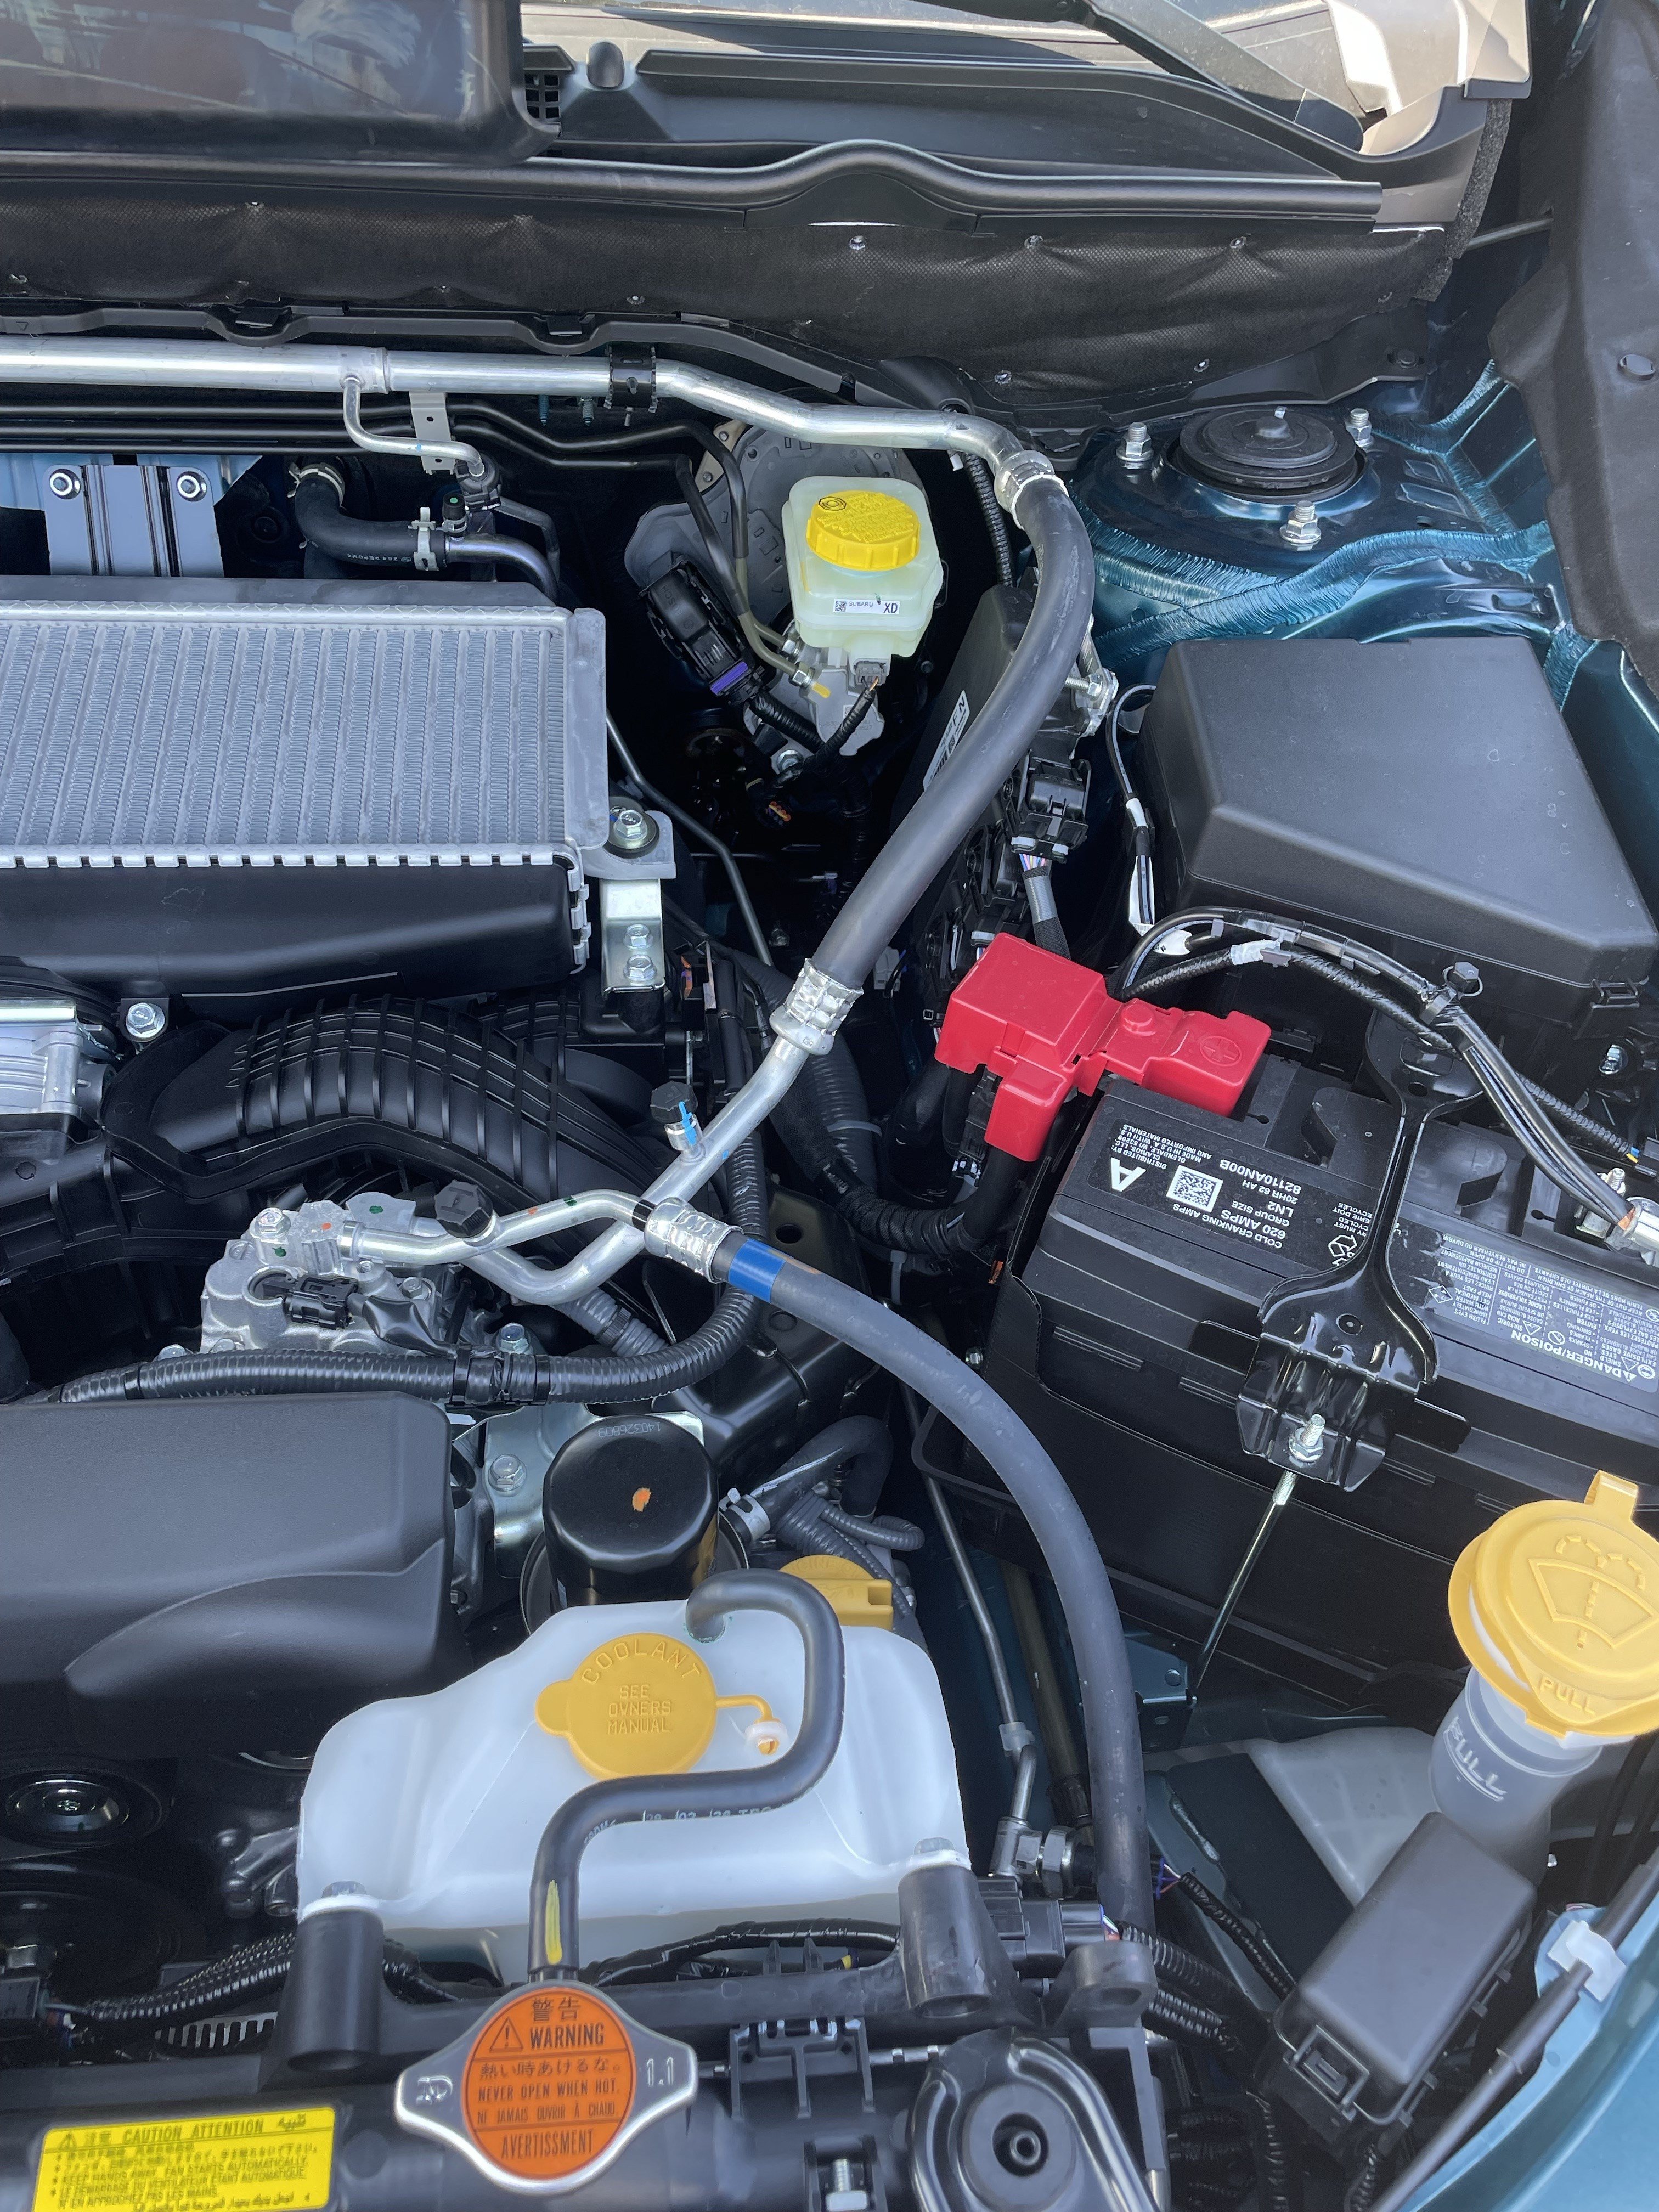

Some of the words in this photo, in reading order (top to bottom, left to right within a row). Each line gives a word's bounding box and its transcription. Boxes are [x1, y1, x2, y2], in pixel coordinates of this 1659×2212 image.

[883, 602, 898, 614] XD
[1119, 1128, 1132, 1137] U.S.
[1122, 1124, 1160, 1141] MATERIALS
[1132, 1133, 1150, 1144] WITH
[1110, 1144, 1122, 1153] BY:
[1150, 1140, 1172, 1152] U.S.A.
[1161, 1138, 1196, 1154] IMPORTED
[1122, 1149, 1167, 1169] DISTRIBUTED
[1181, 1151, 1201, 1163] MADE
[1197, 1150, 1212, 1159] AND
[1110, 1158, 1145, 1191] A
[1220, 1159, 1301, 1194] 82110AN00B
[1242, 1180, 1257, 1189] AH
[1258, 1185, 1270, 1194] 62
[1271, 1190, 1298, 1204] 20HR
[1172, 1203, 1200, 1217] AMPS
[1231, 1200, 1253, 1214] SIZE
[1267, 1201, 1294, 1217] LN2
[1331, 1207, 1351, 1217] DOIT
[1338, 1202, 1372, 1218] ECYCLÉE
[1221, 1209, 1260, 1229] AMPS
[1254, 1210, 1289, 1226] GROUP
[1338, 1217, 1368, 1231] CYCLED
[1352, 1214, 1371, 1224] ERIE
[1201, 1214, 1252, 1238] CRANKING
[1262, 1224, 1285, 1239] 620
[1333, 1221, 1356, 1233] MUST
[1254, 1234, 1282, 1248] COLD
[1473, 1245, 1506, 1261] RENVERSER
[1449, 1271, 1463, 1280] YEUX
[1466, 1264, 1496, 1279] CONSULTEZ
[1464, 1276, 1474, 1284] LES
[1474, 1280, 1493, 1291] RINCEZ
[1560, 1276, 1571, 1284] DES
[1454, 1288, 1479, 1301] MEDICAL
[1477, 1290, 1492, 1299] HELP
[1498, 1289, 1527, 1304] SULFURIQUE
[1514, 1288, 1534, 1299] CAUSER
[1569, 1294, 1588, 1305] FUMER
[1575, 1288, 1594, 1299] REACH
[1594, 1295, 1605, 1303] THE
[1610, 1294, 1626, 1304] HORS
[1479, 1297, 1490, 1305] GET
[1500, 1297, 1517, 1308] BURNS
[1534, 1296, 1547, 1304] PEUT
[1559, 1297, 1584, 1311] FLAMMES
[1627, 1300, 1643, 1310] TENIR
[1452, 1301, 1487, 1318] IMMEDIATELY
[1474, 1301, 1488, 1312] WITH
[1499, 1304, 1526, 1318] BLINDNESS
[1517, 1304, 1536, 1315] SEVERE
[1615, 1302, 1627, 1311] OUT
[1627, 1307, 1642, 1316] KEEP
[1454, 1308, 1468, 1318] EYES
[1468, 1313, 1486, 1324] FLUSH
[1496, 1310, 1507, 1318] CAN
[1507, 1314, 1520, 1323] ACID
[1526, 1314, 1543, 1324] CAUSE
[1584, 1313, 1594, 1321] LES
[1497, 1317, 1523, 1331] SULFURIC
[1566, 1322, 1592, 1335] SMOKING
[1607, 1319, 1637, 1334] EXPLOSIFS
[1569, 1330, 1590, 1341] FLAMES
[1620, 1330, 1630, 1338] LES
[1637, 1330, 1649, 1339] GAZ
[1568, 1336, 1589, 1348] SPARKS
[1601, 1342, 1621, 1354] GASES
[1511, 1330, 1621, 1377] DANGER/POISON
[1622, 1350, 1656, 1367] EXPLOSIVE
[1599, 1355, 1621, 1367] SHIELD
[582, 1640, 702, 1685] COOLANT
[620, 1684, 650, 1699] SEE
[1539, 1674, 1595, 1716] PULL
[608, 1700, 672, 1717] OWNERS
[607, 1717, 671, 1735] MANUAL
[1444, 1717, 1507, 1796] FULL
[532, 1996, 580, 2023] 警告
[530, 2022, 605, 2050] WARNING
[646, 2056, 674, 2086] 1.1
[478, 2085, 514, 2102] NEVER
[521, 2083, 550, 2100] OPEN
[557, 2079, 588, 2096] WHEN
[123, 2125, 183, 2145] CAUTION
[192, 2119, 263, 2138] ATTENTION
[500, 2129, 594, 2159] AVERTISSMENT
